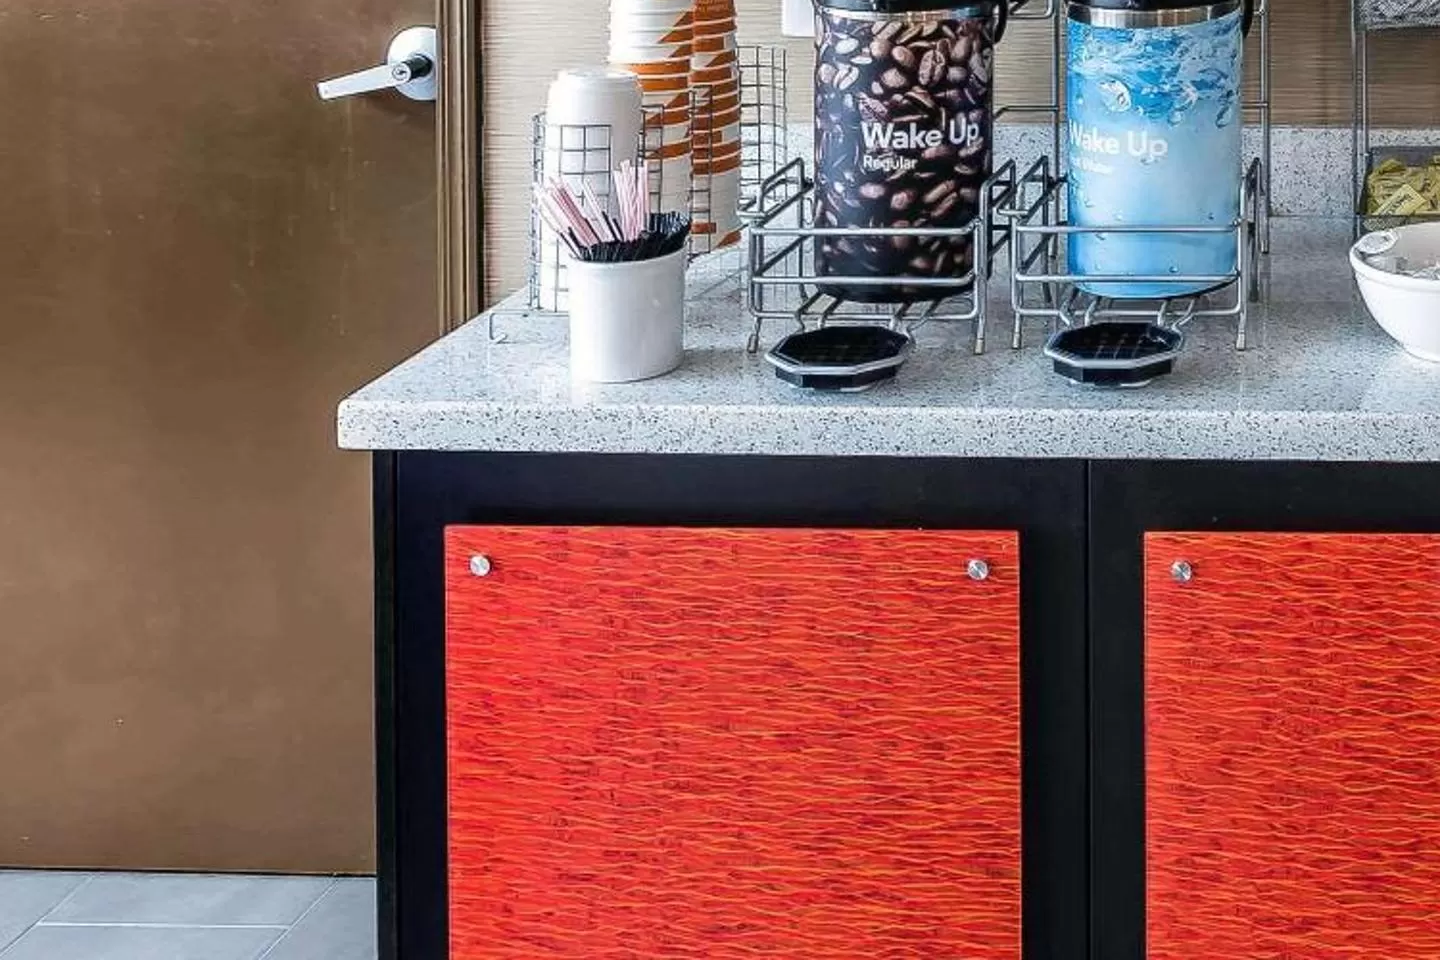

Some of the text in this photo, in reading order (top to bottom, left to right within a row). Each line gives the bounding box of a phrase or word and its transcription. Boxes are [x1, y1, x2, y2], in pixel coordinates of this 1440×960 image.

[860, 119, 980, 149] Wake Up
[1069, 120, 1169, 161] Wake Up
[863, 155, 919, 172] Regular
